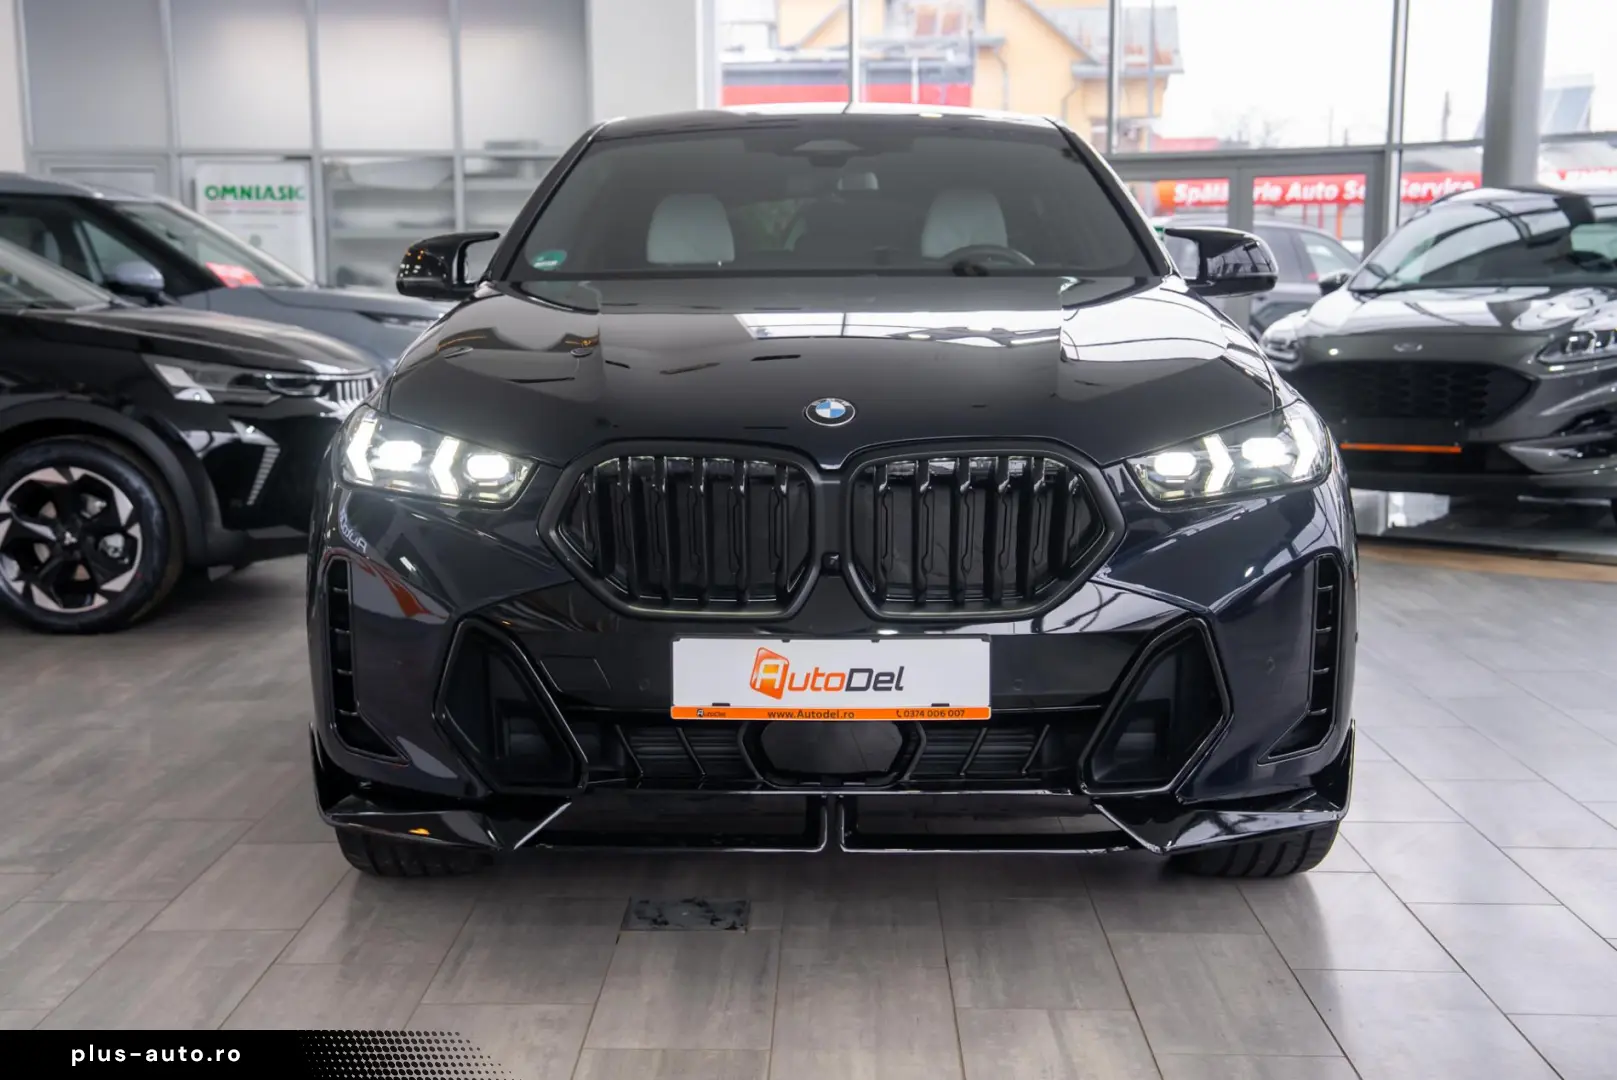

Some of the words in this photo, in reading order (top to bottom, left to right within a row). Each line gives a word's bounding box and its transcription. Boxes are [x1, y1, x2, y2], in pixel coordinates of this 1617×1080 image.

[1285, 181, 1339, 201] Auto
[753, 652, 905, 694] AutoDel
[767, 709, 855, 719] www.Autodel.ro
[903, 709, 925, 718] 0374
[927, 709, 945, 718] 006
[948, 709, 965, 718] 007
